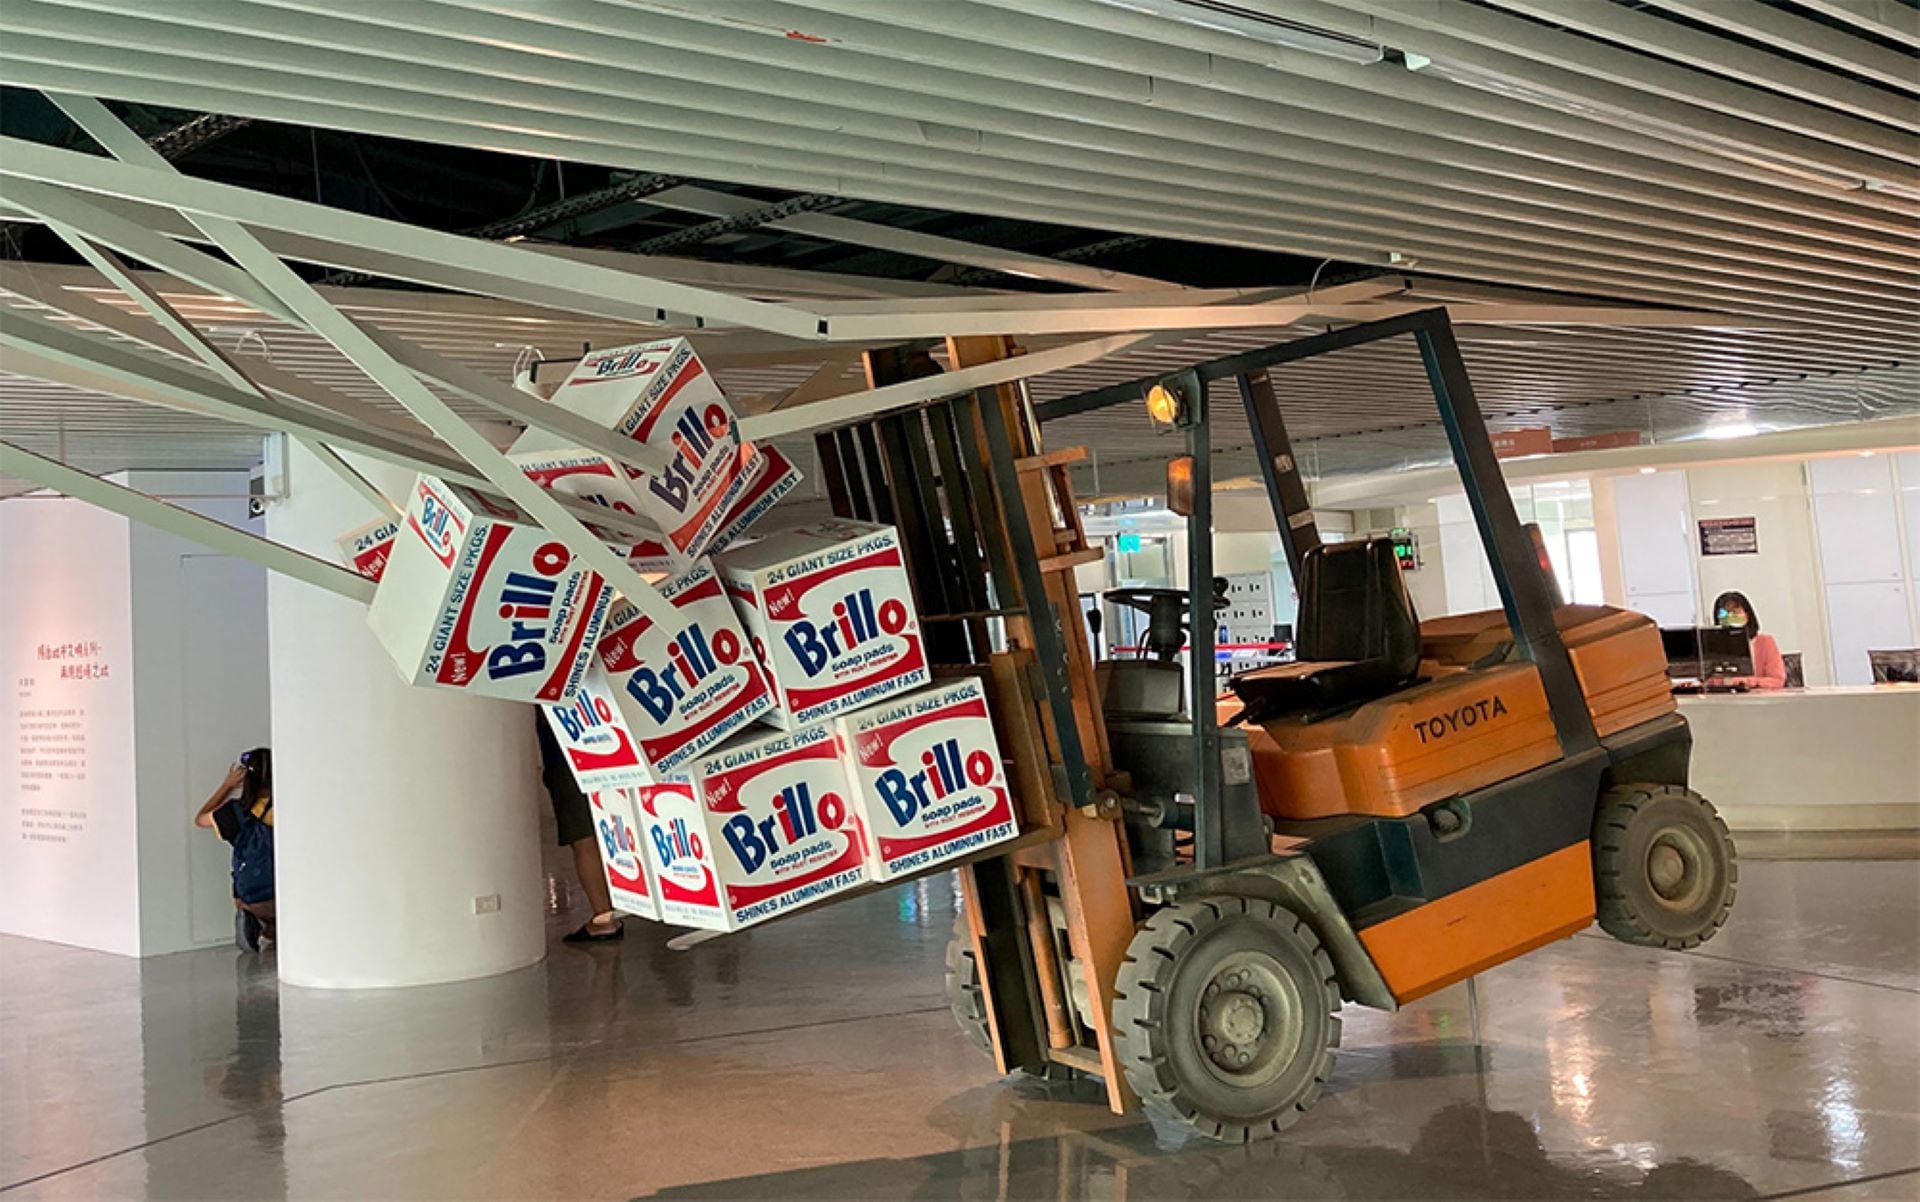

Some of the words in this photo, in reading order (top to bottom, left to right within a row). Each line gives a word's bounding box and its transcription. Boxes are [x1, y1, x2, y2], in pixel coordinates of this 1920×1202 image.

[597, 351, 649, 376] Brillo
[649, 403, 727, 513] Brillo
[422, 497, 451, 546] Brillo
[686, 521, 713, 558] SHINES
[711, 476, 744, 523] ALUMINUM
[727, 494, 775, 540] ALUMINUM
[771, 471, 797, 498] FAST
[354, 535, 373, 551] 24
[375, 523, 398, 540] GIA
[767, 569, 784, 584] 24
[787, 556, 825, 578] GIANT
[827, 546, 854, 564] SIZE
[425, 655, 441, 674] 24
[433, 607, 459, 652] GIANT
[451, 572, 472, 603] SIZE
[487, 541, 571, 680] Brillo
[549, 608, 567, 644] soap
[562, 571, 580, 607] pads
[769, 587, 795, 617] New!
[564, 652, 589, 697] SHINES
[583, 586, 614, 649] ALUMINUM
[603, 636, 628, 669] New!
[784, 588, 907, 678] Brillo
[832, 654, 861, 672] soap
[863, 643, 895, 662] pads
[450, 652, 468, 684] New!
[627, 623, 740, 725] Brillo
[552, 687, 612, 742] Brillo
[679, 692, 707, 714] soap
[707, 674, 735, 697] pads
[798, 700, 839, 723] SHINES
[841, 680, 896, 707] ALUMINUM
[897, 669, 925, 687] FAST
[877, 704, 912, 724] GIANT
[915, 697, 942, 713] SIZE
[657, 742, 696, 774] SHINES
[696, 709, 746, 749] ALUMINUM
[744, 693, 770, 717] FAST
[1414, 695, 1508, 744] TOYOTA
[704, 762, 722, 775] 24
[724, 749, 761, 768] GIANT
[763, 737, 791, 755] SIZE
[859, 732, 884, 762] New!
[705, 778, 732, 808] New!
[875, 738, 994, 828] Brillo
[721, 782, 845, 876] Brillo
[921, 805, 951, 822] soap
[952, 795, 983, 814] pads
[600, 814, 636, 858] Brillo
[651, 818, 704, 867] Brillo
[770, 852, 800, 869] soap
[801, 840, 832, 859] pads
[890, 851, 930, 874] SHINES
[932, 833, 984, 859] ALUMINUM
[985, 822, 1013, 842] FAST
[736, 899, 778, 923] SHINES
[780, 878, 835, 908] ALUMINUM
[836, 867, 863, 888] FAST
